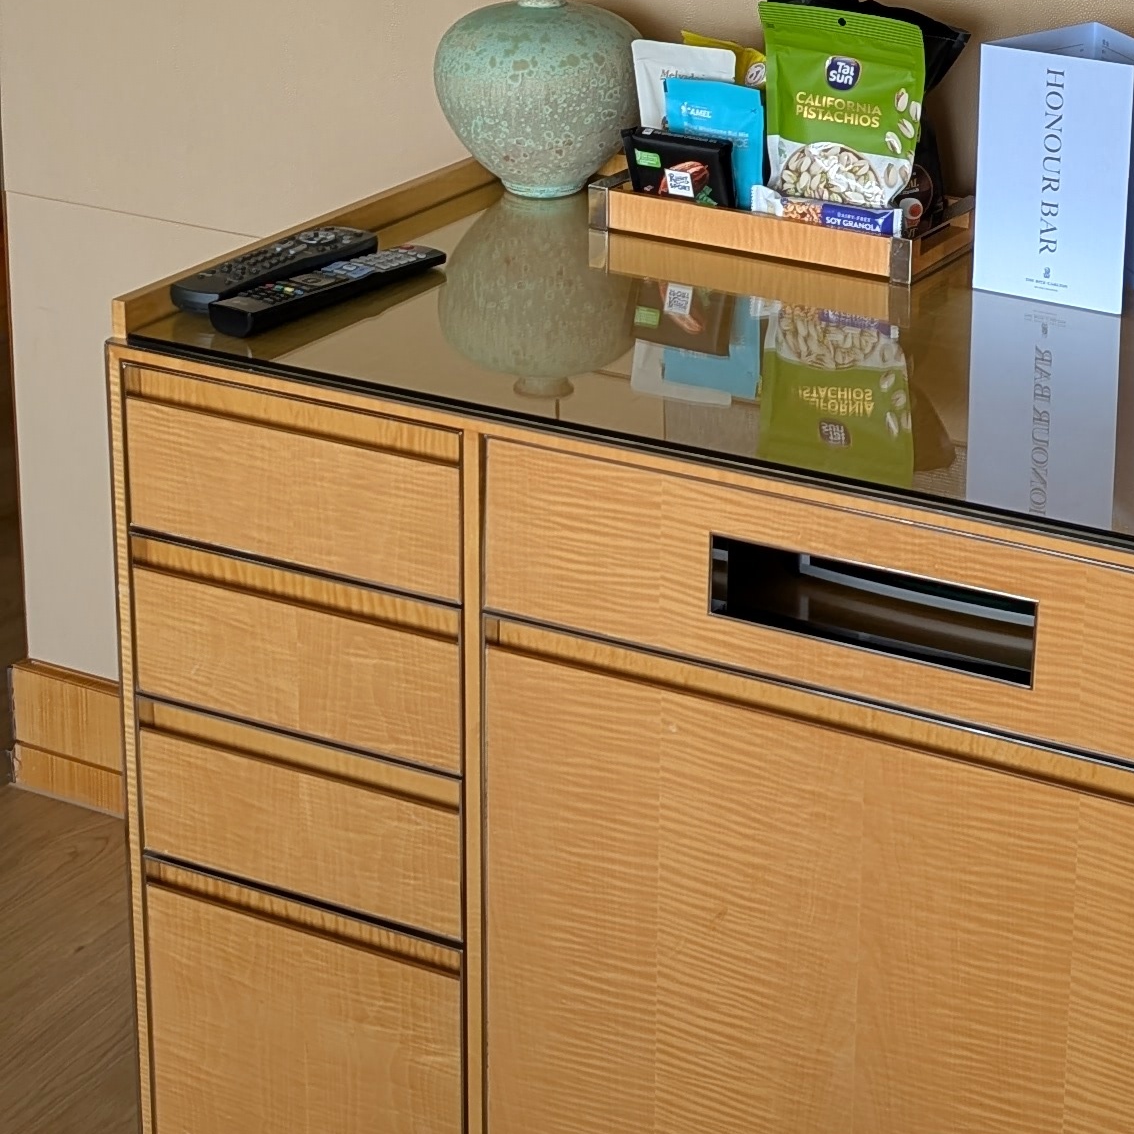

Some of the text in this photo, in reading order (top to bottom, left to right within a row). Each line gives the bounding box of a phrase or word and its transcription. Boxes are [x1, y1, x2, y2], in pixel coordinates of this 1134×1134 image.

[829, 70, 853, 85] Sun
[837, 61, 855, 76] Tai
[796, 91, 882, 116] CALIFORNIA
[796, 104, 880, 128] PISTACHIOS
[1038, 68, 1065, 255] HONOUR BAR
[825, 216, 881, 233] SOY GRANOLA
